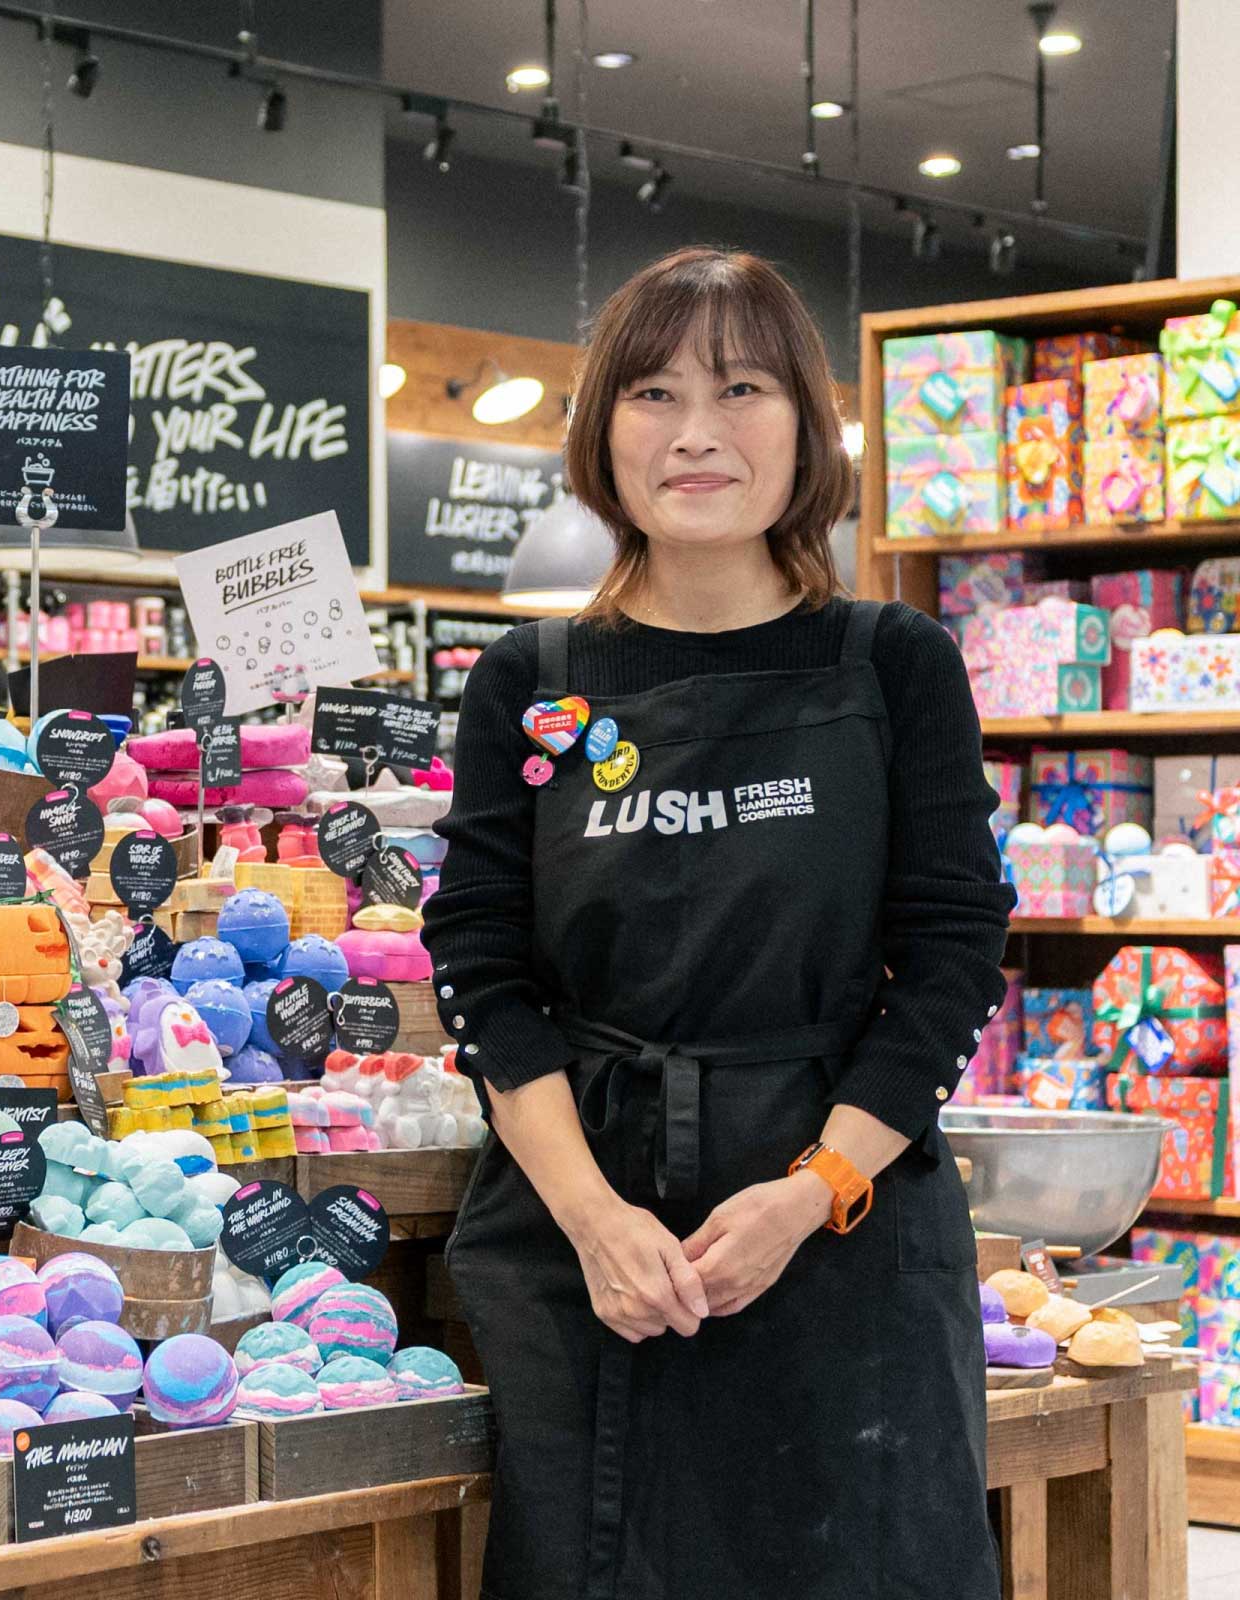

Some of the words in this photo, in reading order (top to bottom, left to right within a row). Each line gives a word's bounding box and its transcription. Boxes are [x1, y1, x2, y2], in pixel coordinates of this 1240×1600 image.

[63, 369, 106, 389] FOR
[89, 338, 267, 404] ATTERS
[57, 390, 100, 411] AND
[151, 405, 244, 461] YOUR
[249, 398, 349, 461] LIFE
[215, 553, 265, 584] BOTTLE
[268, 539, 307, 566] FREE
[223, 559, 314, 605] BUBBLES
[596, 753, 635, 787] WONDERFUL
[734, 777, 811, 802] FRESH
[736, 794, 813, 813] HANDMADE
[584, 790, 728, 838] LUSH
[738, 804, 815, 823] COSMETICS
[272, 1188, 283, 1201] IN
[25, 1445, 53, 1470] THE
[56, 1436, 128, 1463] MAGICIAN
[64, 1508, 92, 1525] ¥1300
